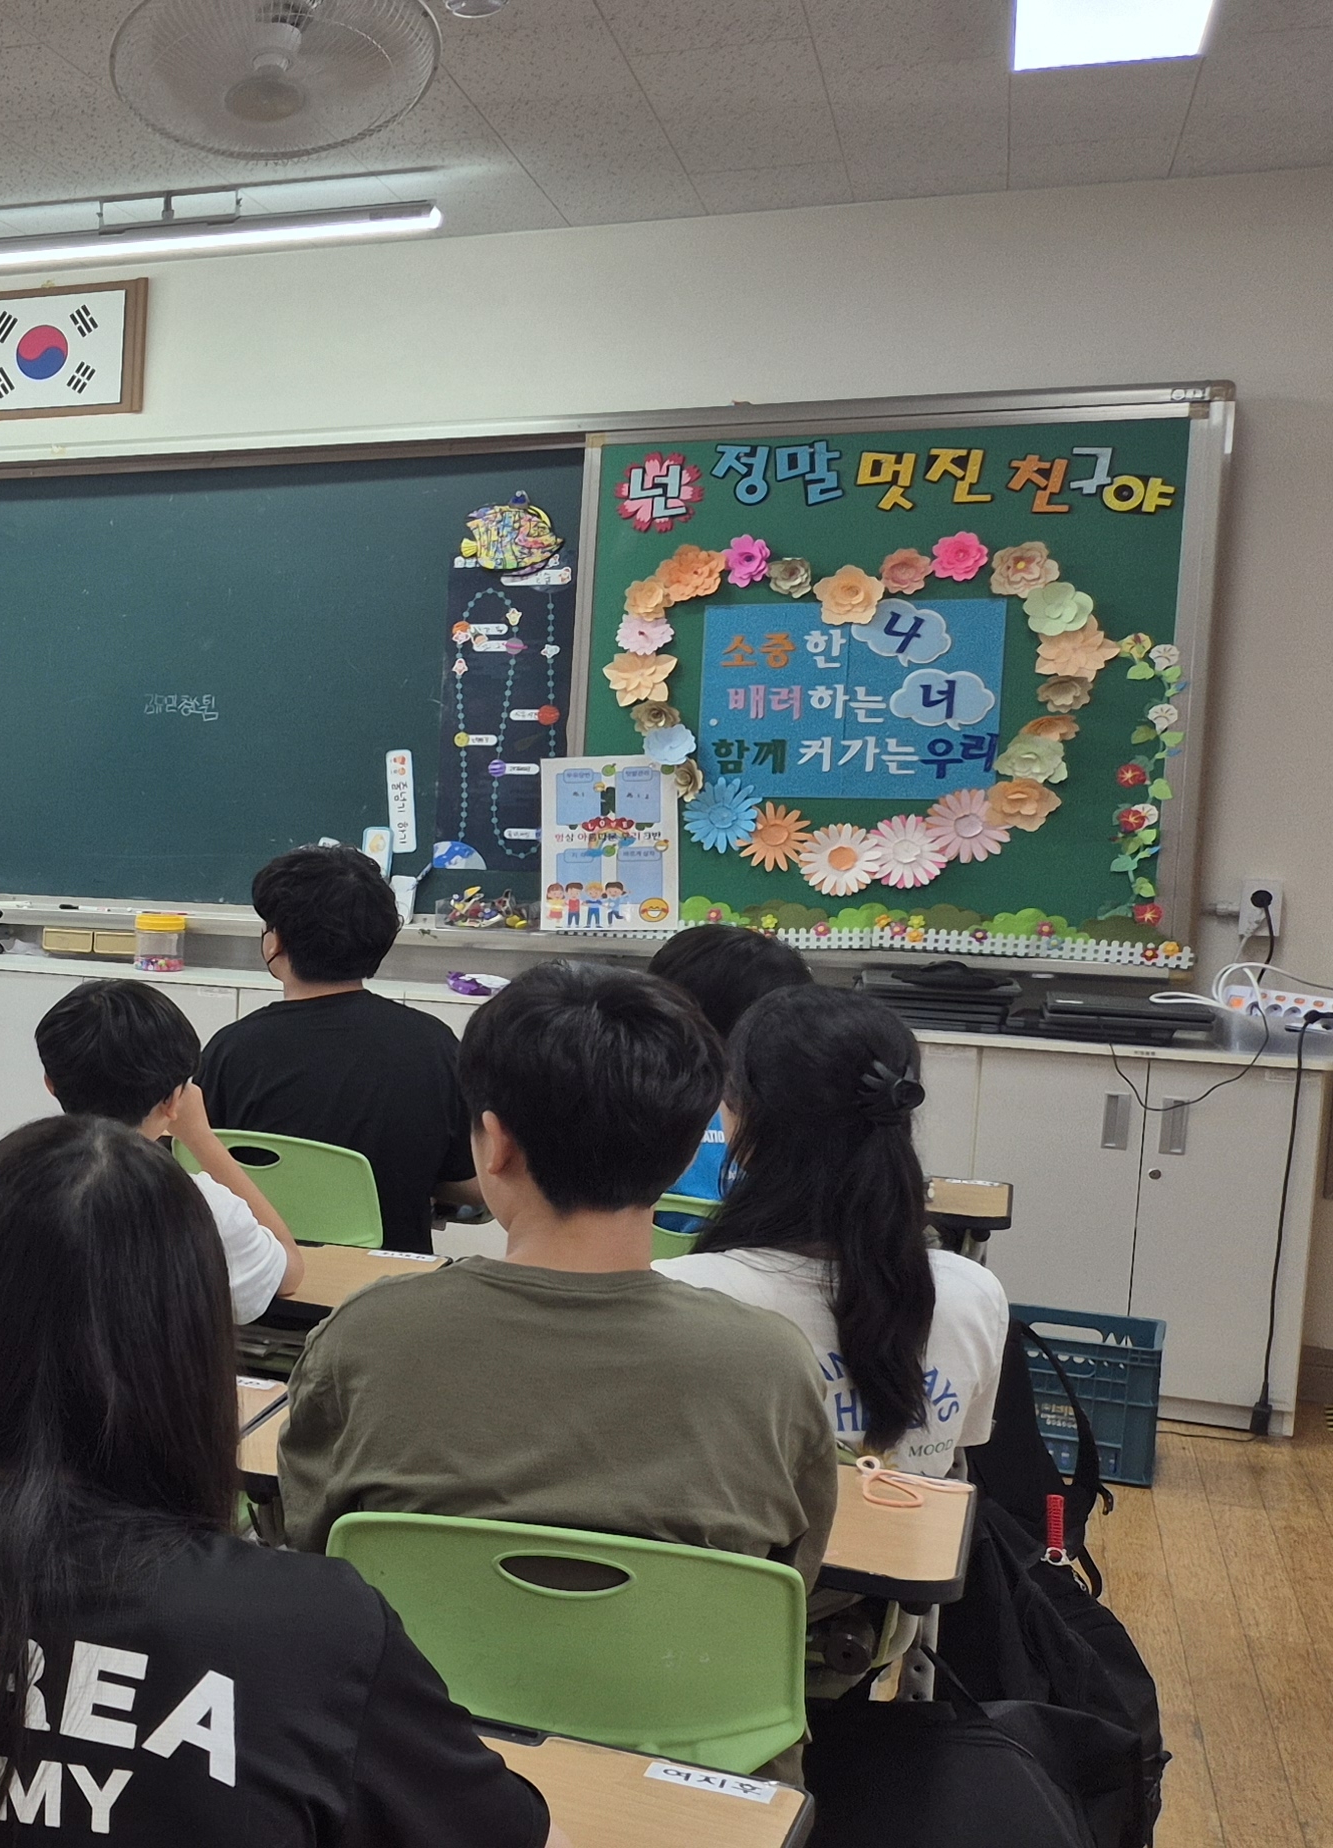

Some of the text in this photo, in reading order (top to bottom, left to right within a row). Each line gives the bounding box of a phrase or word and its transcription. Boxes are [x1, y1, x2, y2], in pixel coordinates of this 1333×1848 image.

[629, 440, 1176, 520] 넌 정말 멋진 친구야
[884, 609, 923, 654] 나
[920, 680, 956, 722] 너
[714, 737, 787, 776] 함께
[587, 820, 629, 830] LOVE
[908, 1438, 954, 1458] MOOD
[662, 1767, 763, 1796] 여지후
